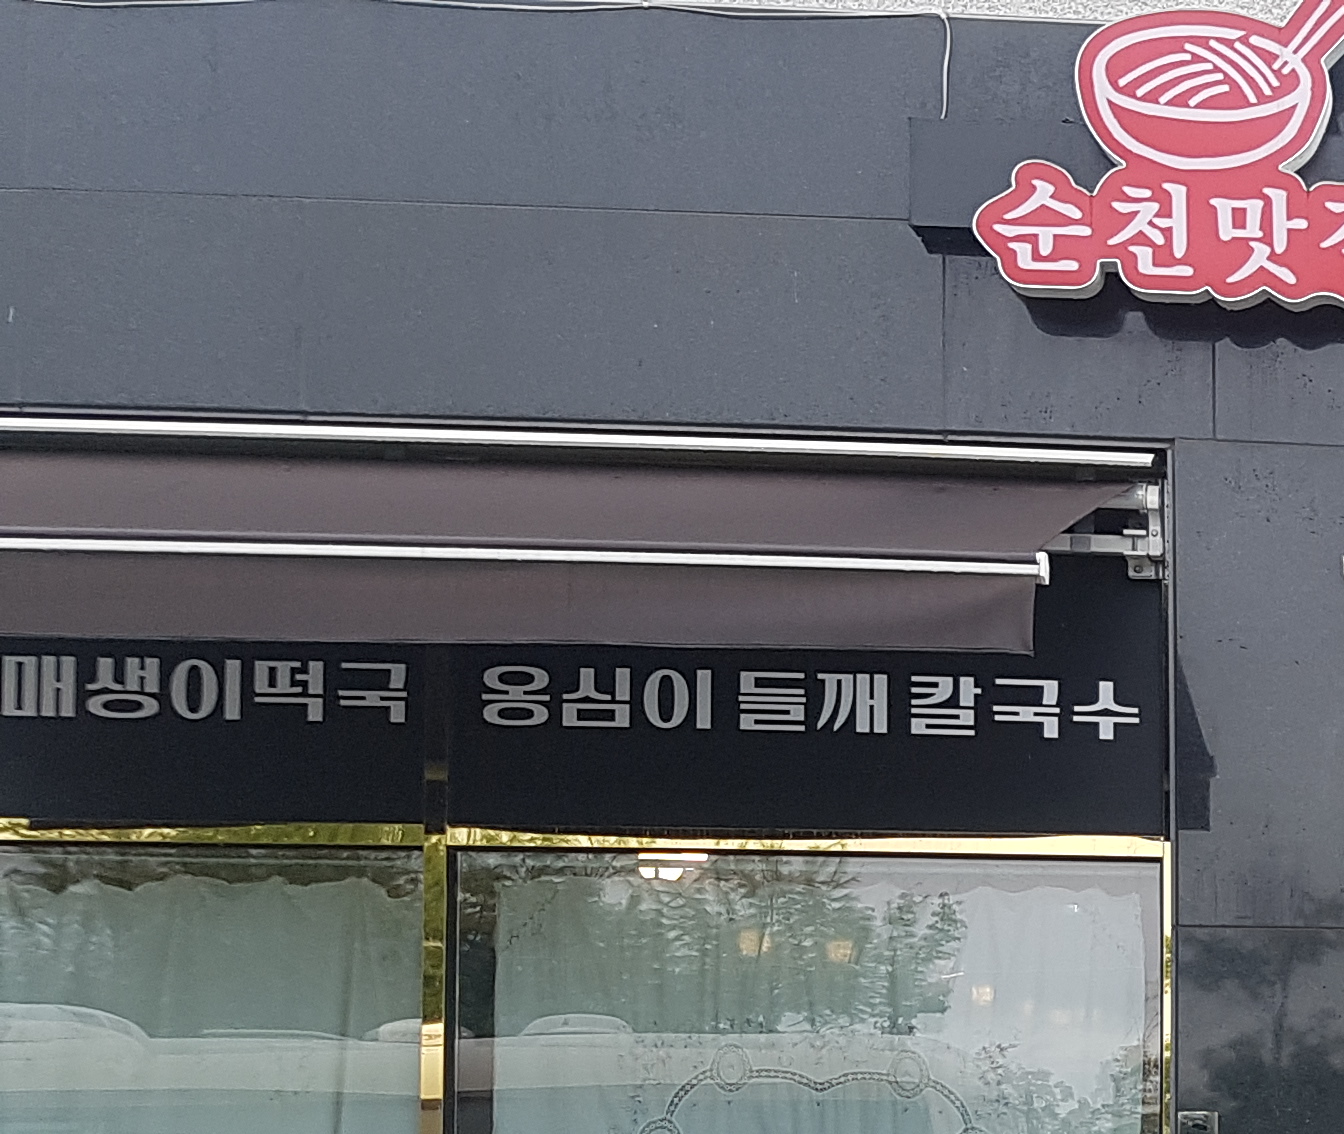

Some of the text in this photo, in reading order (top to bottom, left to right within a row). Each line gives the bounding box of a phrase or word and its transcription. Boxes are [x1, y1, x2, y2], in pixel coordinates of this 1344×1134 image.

[1, 655, 408, 724] 매생이떡국
[481, 666, 1140, 740] 옹심이 들깨 칼국수
